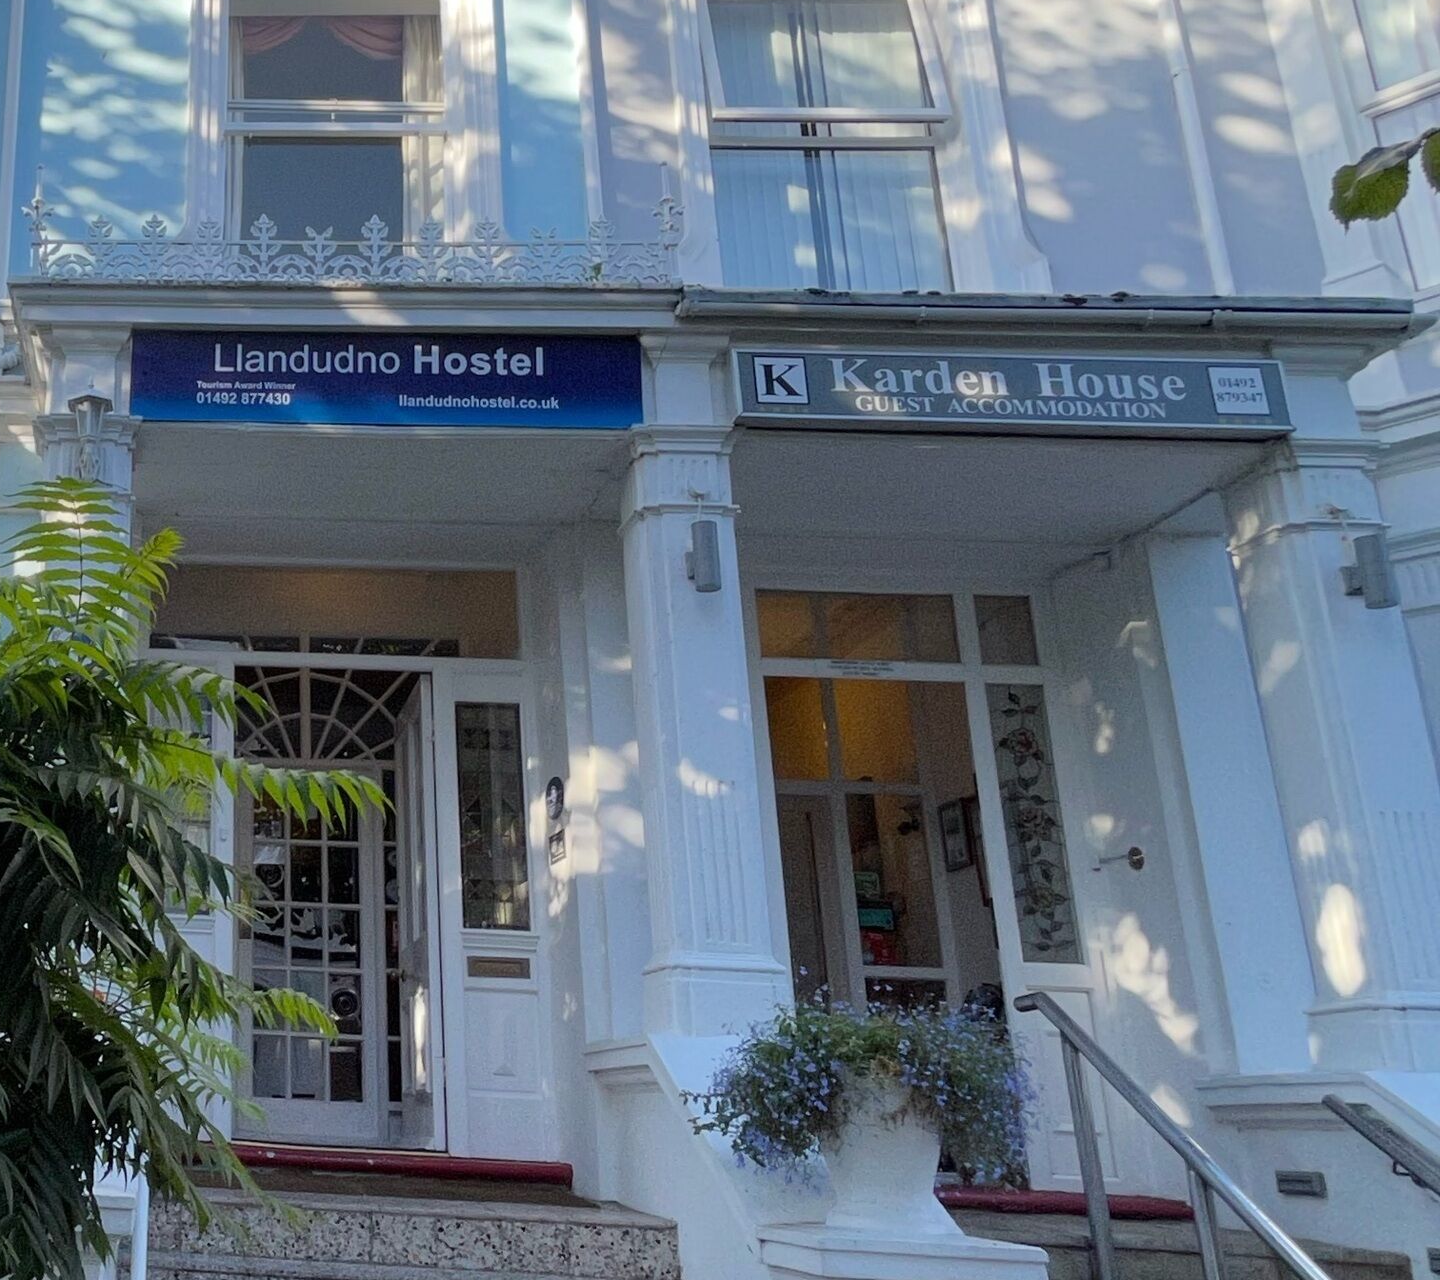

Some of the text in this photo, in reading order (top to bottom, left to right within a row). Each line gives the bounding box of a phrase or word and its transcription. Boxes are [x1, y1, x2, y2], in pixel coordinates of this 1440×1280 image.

[214, 343, 544, 376] Llandudno Hostel
[196, 380, 296, 391] Tourism Award Winner
[760, 364, 803, 397] K
[828, 357, 1187, 401] Karden House
[1217, 376, 1256, 389] 01492
[196, 392, 291, 406] 01492 877430
[398, 394, 560, 409] llandudnohostel.co.uk
[855, 395, 1167, 419] GUEST ACCOMMODATION
